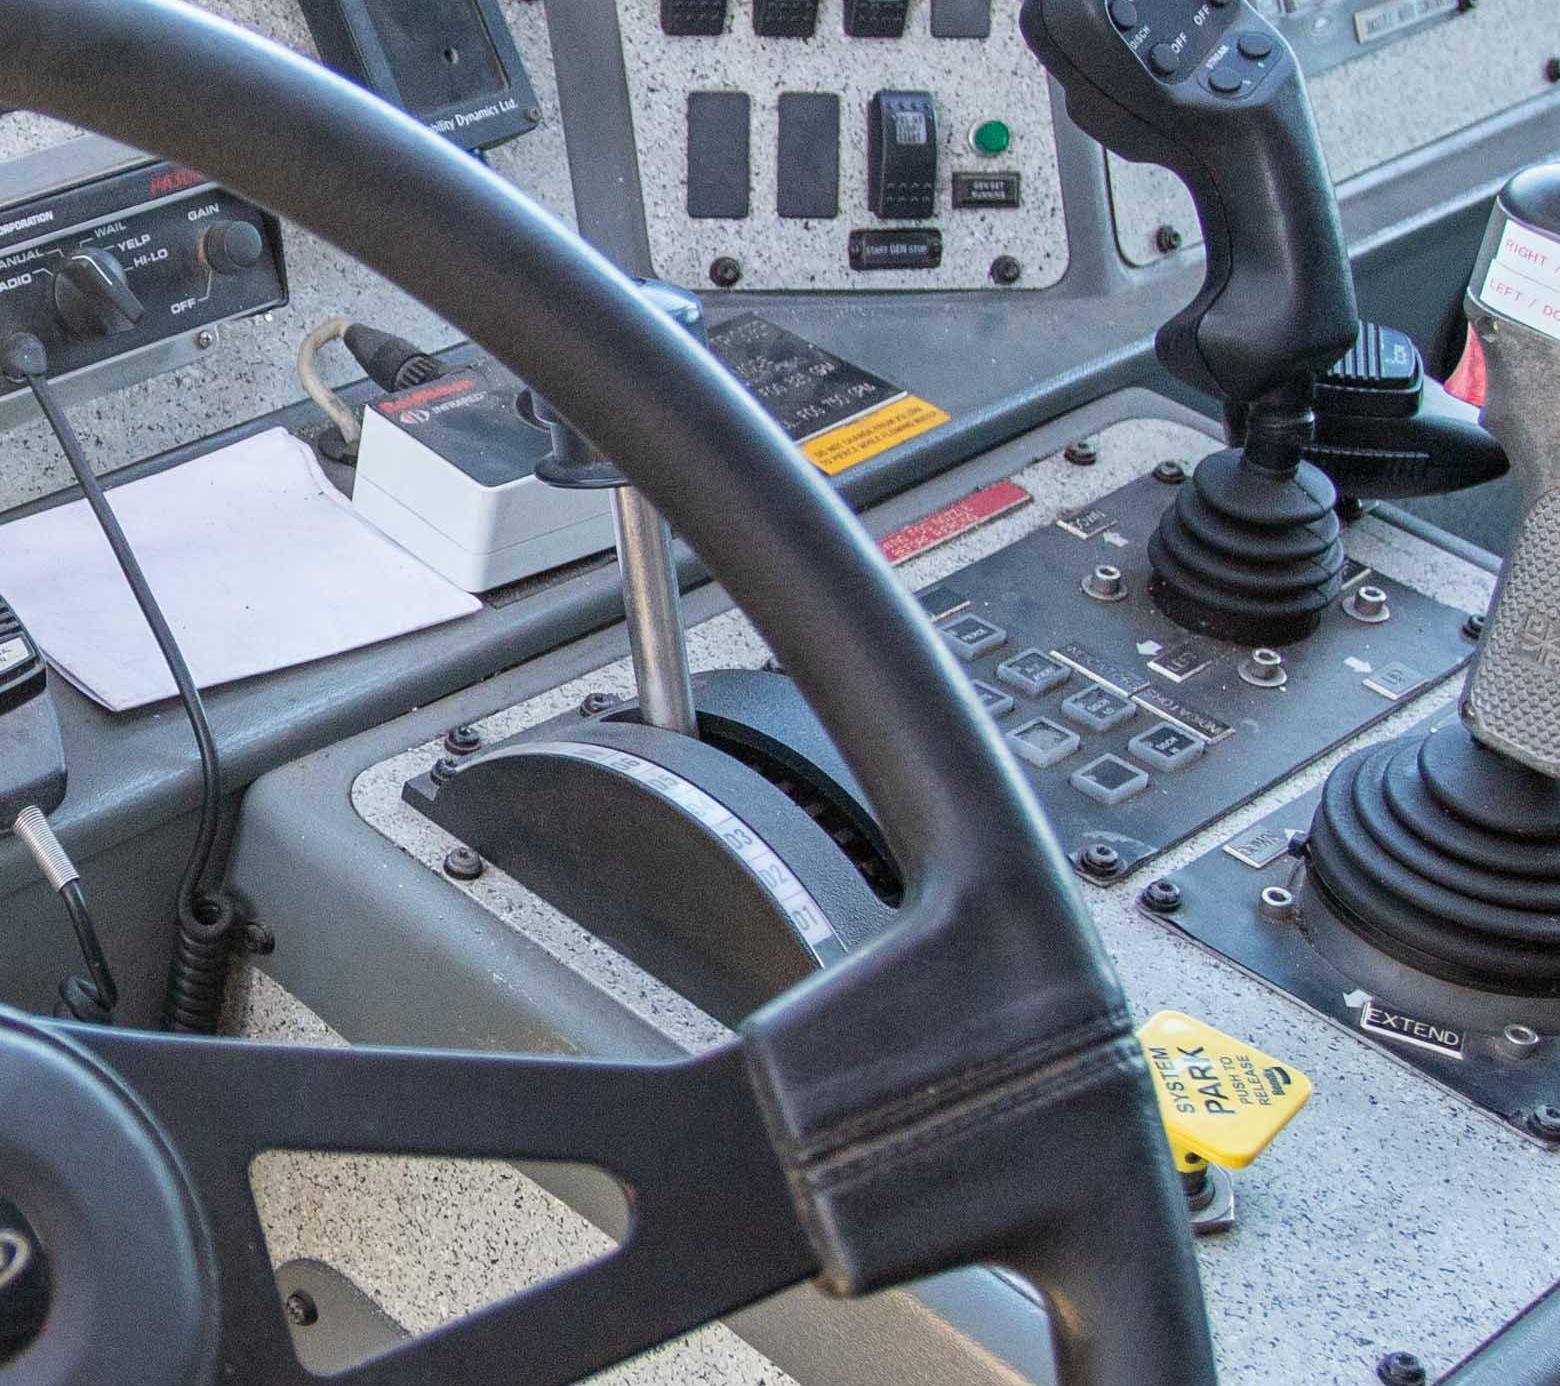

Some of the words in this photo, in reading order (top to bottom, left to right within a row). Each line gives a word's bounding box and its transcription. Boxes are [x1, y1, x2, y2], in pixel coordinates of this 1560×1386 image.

[1193, 4, 1210, 26] OFF
[1130, 25, 1151, 50] DISCH
[1171, 32, 1187, 54] OFF
[456, 102, 500, 127] Dynamics
[498, 97, 518, 113] Ltd.
[188, 203, 219, 222] GAIN
[94, 221, 128, 239] WAIL
[118, 234, 151, 253] YELP
[1504, 239, 1548, 267] RIGHT
[133, 247, 169, 267] HI-LO
[1489, 278, 1523, 302] LEFT
[171, 297, 197, 315] OFF
[1368, 1006, 1460, 1047] EXTEND
[1220, 1056, 1235, 1070] TO
[1148, 1047, 1195, 1113] SYSTEM
[1176, 1046, 1236, 1114] PARK
[1229, 1075, 1254, 1105] PUSH
[1237, 1055, 1272, 1106] RELEASE
